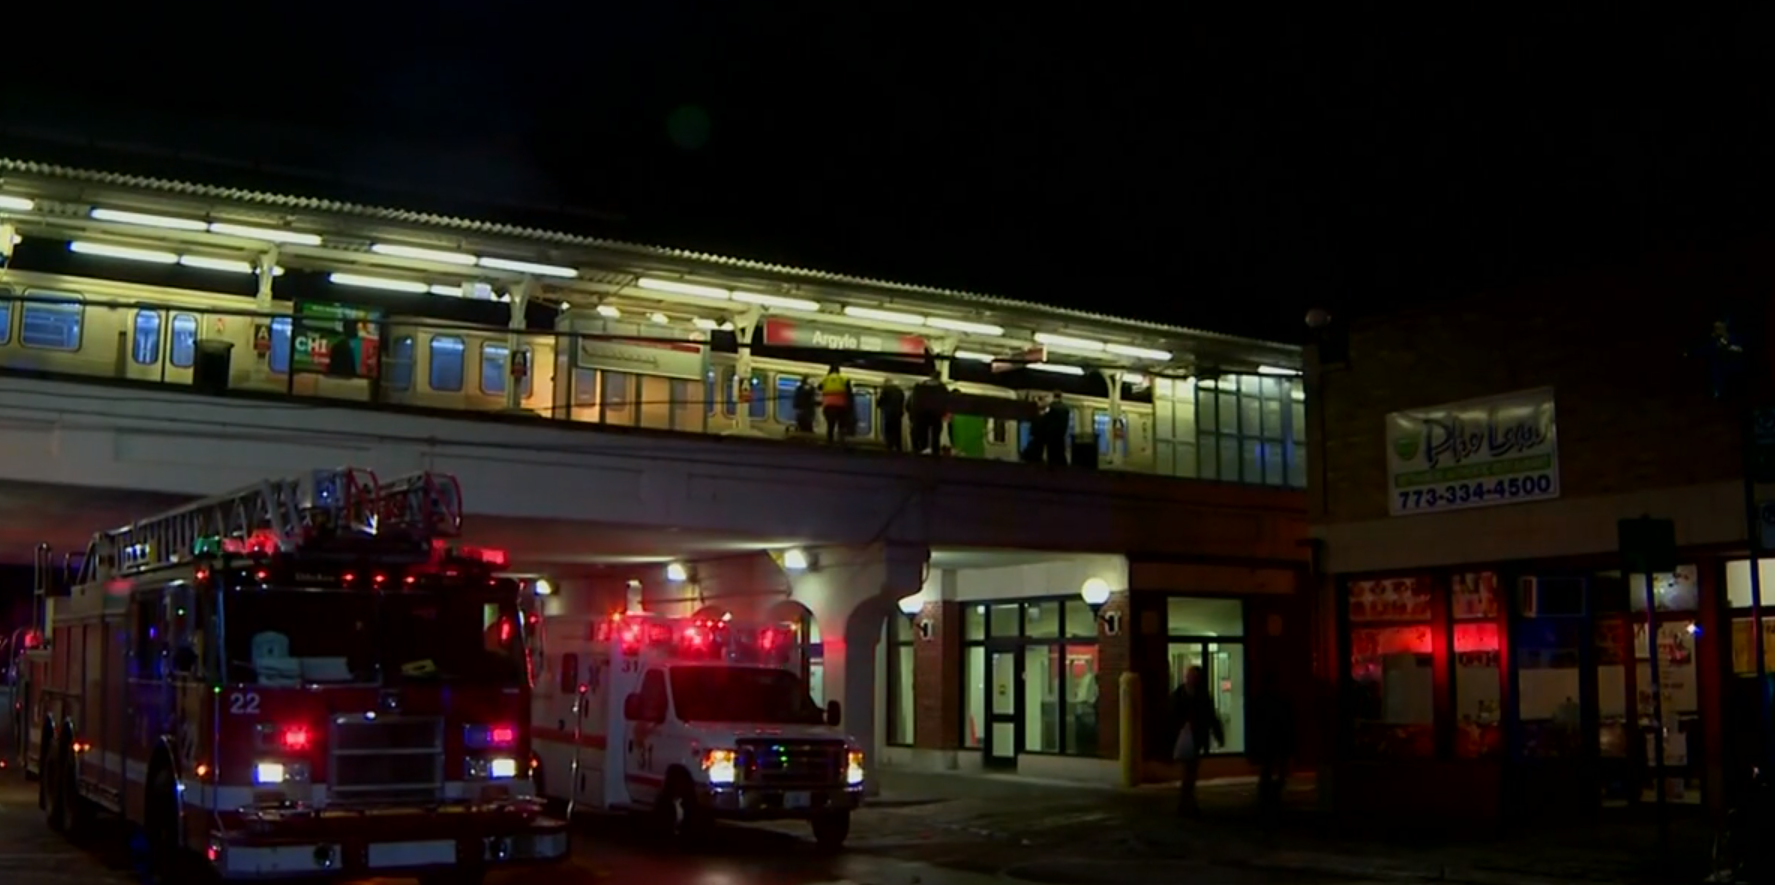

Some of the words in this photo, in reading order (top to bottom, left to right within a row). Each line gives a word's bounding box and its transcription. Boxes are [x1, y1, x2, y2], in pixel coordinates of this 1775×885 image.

[812, 331, 858, 349] Argyle
[1422, 415, 1485, 469] Pho
[1399, 474, 1551, 509] 773-334-4500
[621, 659, 638, 673] 31
[229, 692, 261, 714] 22
[637, 743, 654, 772] 31
